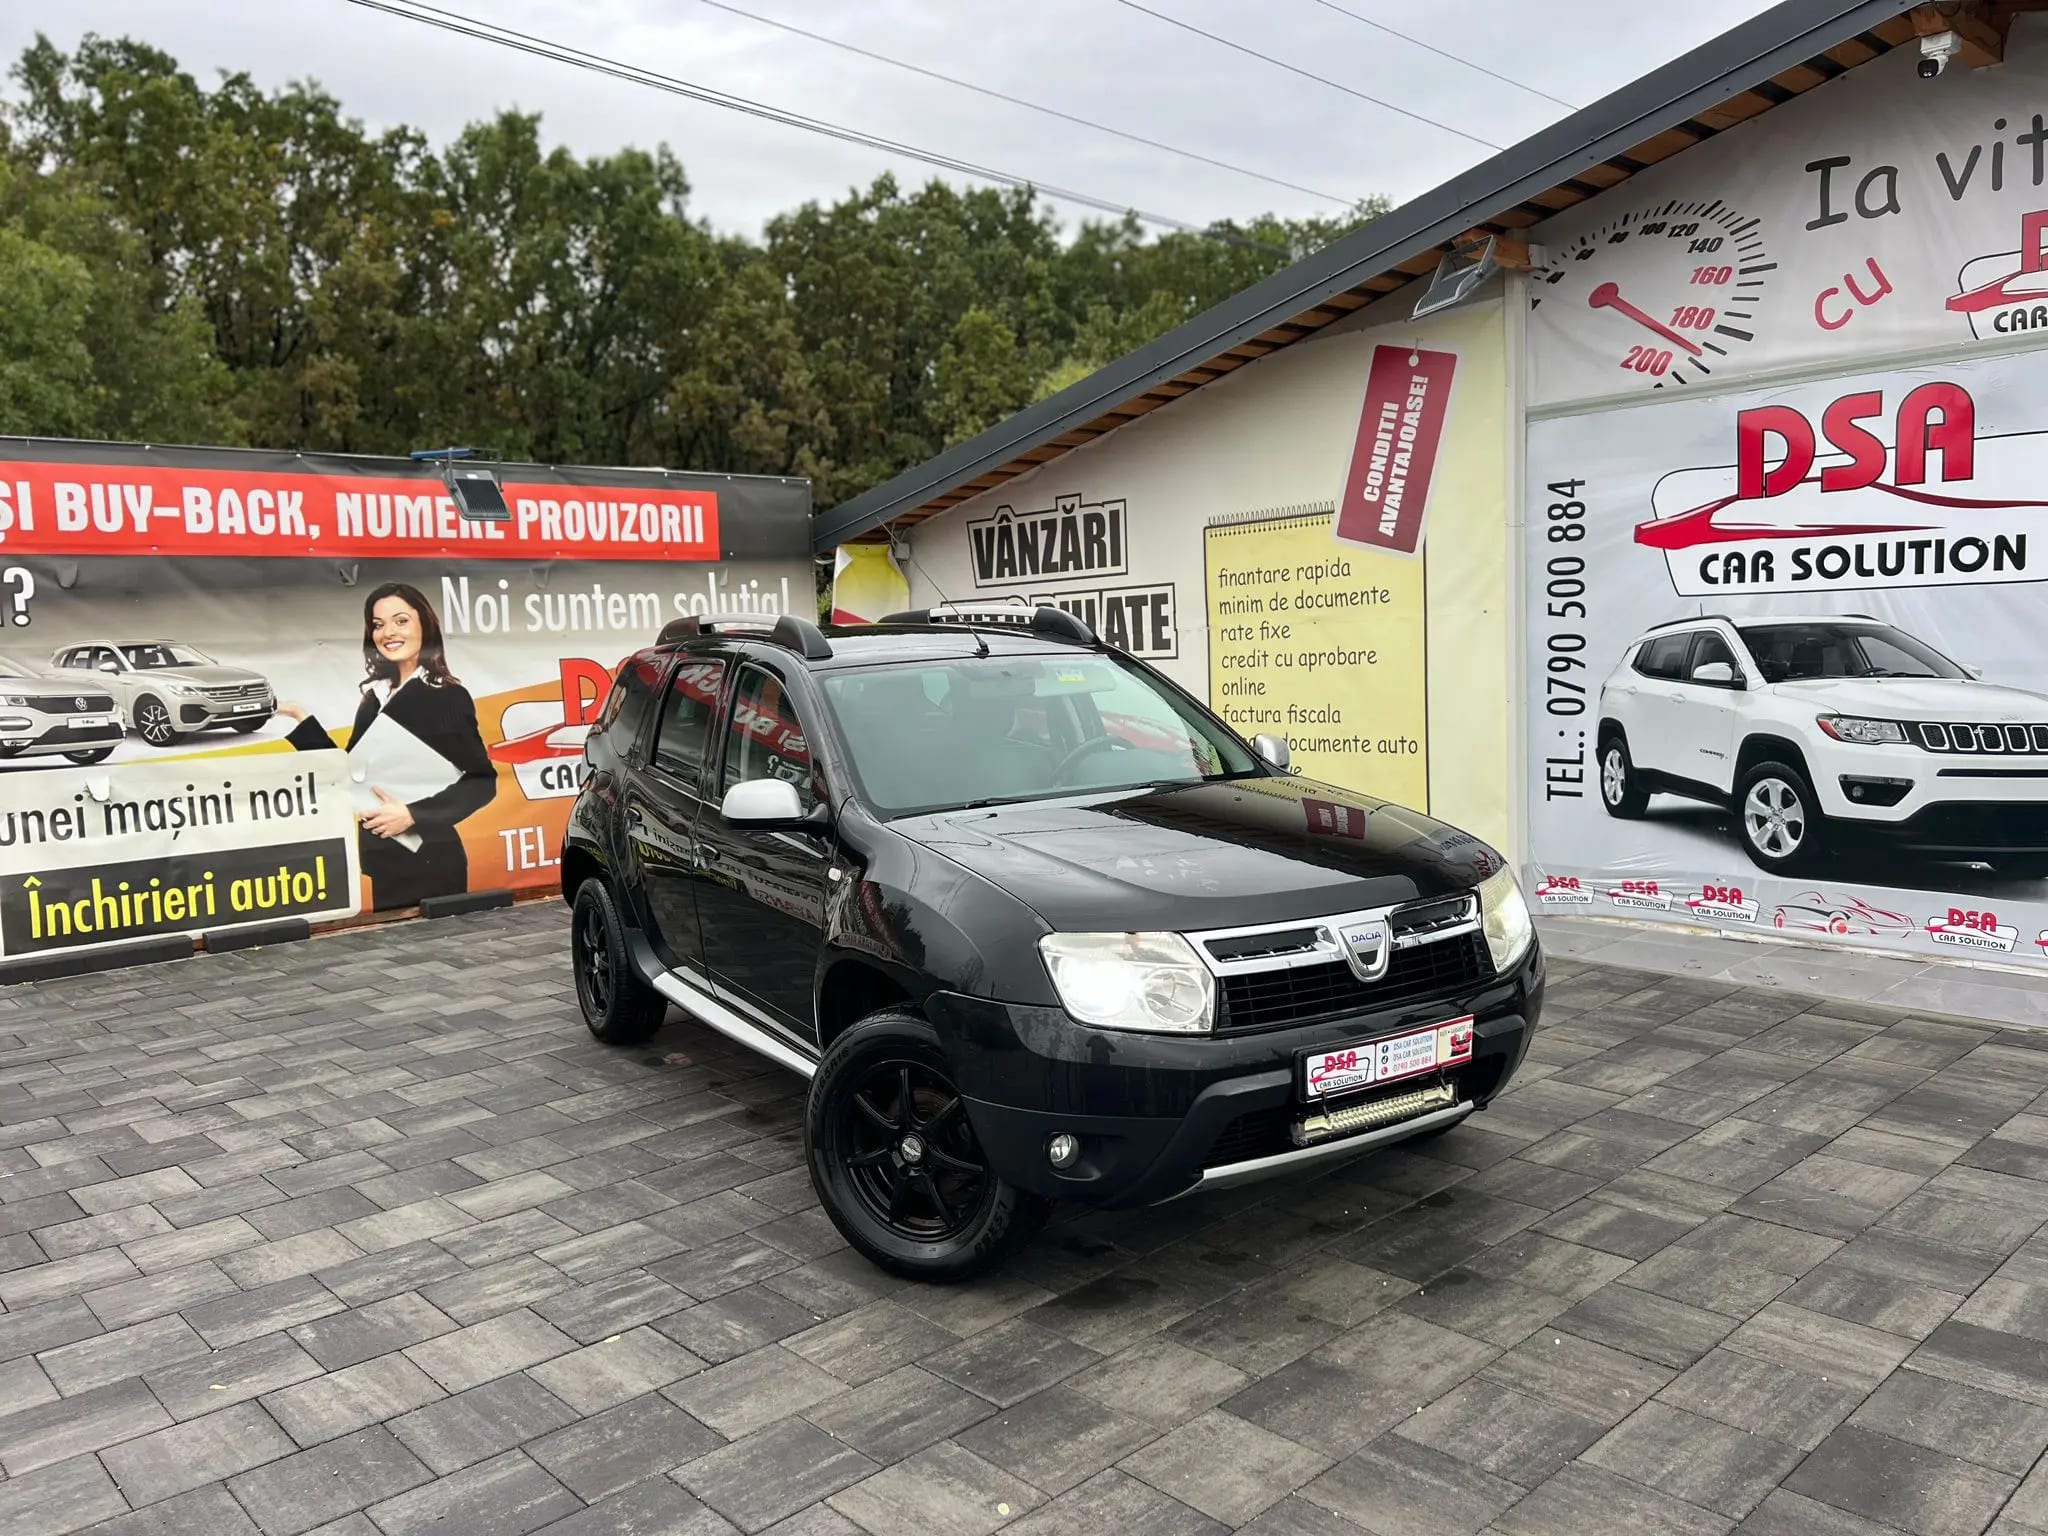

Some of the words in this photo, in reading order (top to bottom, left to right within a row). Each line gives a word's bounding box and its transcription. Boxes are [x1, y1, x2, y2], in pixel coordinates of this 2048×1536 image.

[1805, 156, 1901, 231] Ia
[1639, 222, 1667, 235] 100
[1667, 223, 1700, 238] 120
[1688, 237, 1724, 253] 140
[1690, 266, 1732, 285] 160
[1815, 257, 1893, 330] cu
[1669, 306, 1715, 330] 180
[1620, 345, 1673, 376] 200
[1363, 402, 1399, 502] CONDITII
[1737, 382, 1975, 499] DSA
[1378, 375, 1429, 537] AVANTAJOASE!
[54, 482, 319, 540] BUY-BACK,
[516, 499, 704, 543] PROVIZORII
[1547, 478, 1586, 542] 884
[973, 503, 1122, 580] VÂNZĂRI
[1700, 550, 1774, 586] CAR
[1791, 533, 2026, 582] SOLUTION
[1218, 566, 1291, 587] finantare
[1296, 557, 1351, 585] rapida
[1546, 556, 1586, 618] 500
[441, 576, 511, 634] Noi
[526, 583, 662, 633] suntem
[1219, 594, 1263, 615] minim
[1269, 592, 1289, 611] de
[1294, 586, 1391, 610] documente
[1220, 625, 1254, 642] rate
[1259, 620, 1291, 640] fixe
[1222, 648, 1269, 668] credit
[1275, 653, 1293, 667] cu
[1298, 646, 1377, 672] aprobare
[1222, 677, 1266, 695] online
[1546, 633, 1586, 716] 0790
[1222, 704, 1281, 724] factura
[1287, 704, 1341, 724] fiscala
[1377, 736, 1418, 754] auto
[104, 780, 234, 840] mașini
[248, 771, 319, 820] noi!
[1546, 875, 1580, 889] DSA
[1622, 880, 1659, 895] DSA
[1703, 884, 1742, 904] DSA
[23, 871, 217, 939] Închirieri
[231, 856, 327, 912] auto!
[1557, 895, 1589, 904] SOLUTION
[1632, 898, 1666, 910] SOLUTION
[1713, 909, 1751, 920] SOLUTION
[1948, 908, 1997, 932] DSA
[1351, 930, 1382, 943] DACIA
[1938, 933, 1956, 943] CAR
[1958, 936, 2006, 950] SOLUTION
[1325, 1051, 1356, 1072] DSA
[1333, 1075, 1362, 1086] SOLUTION
